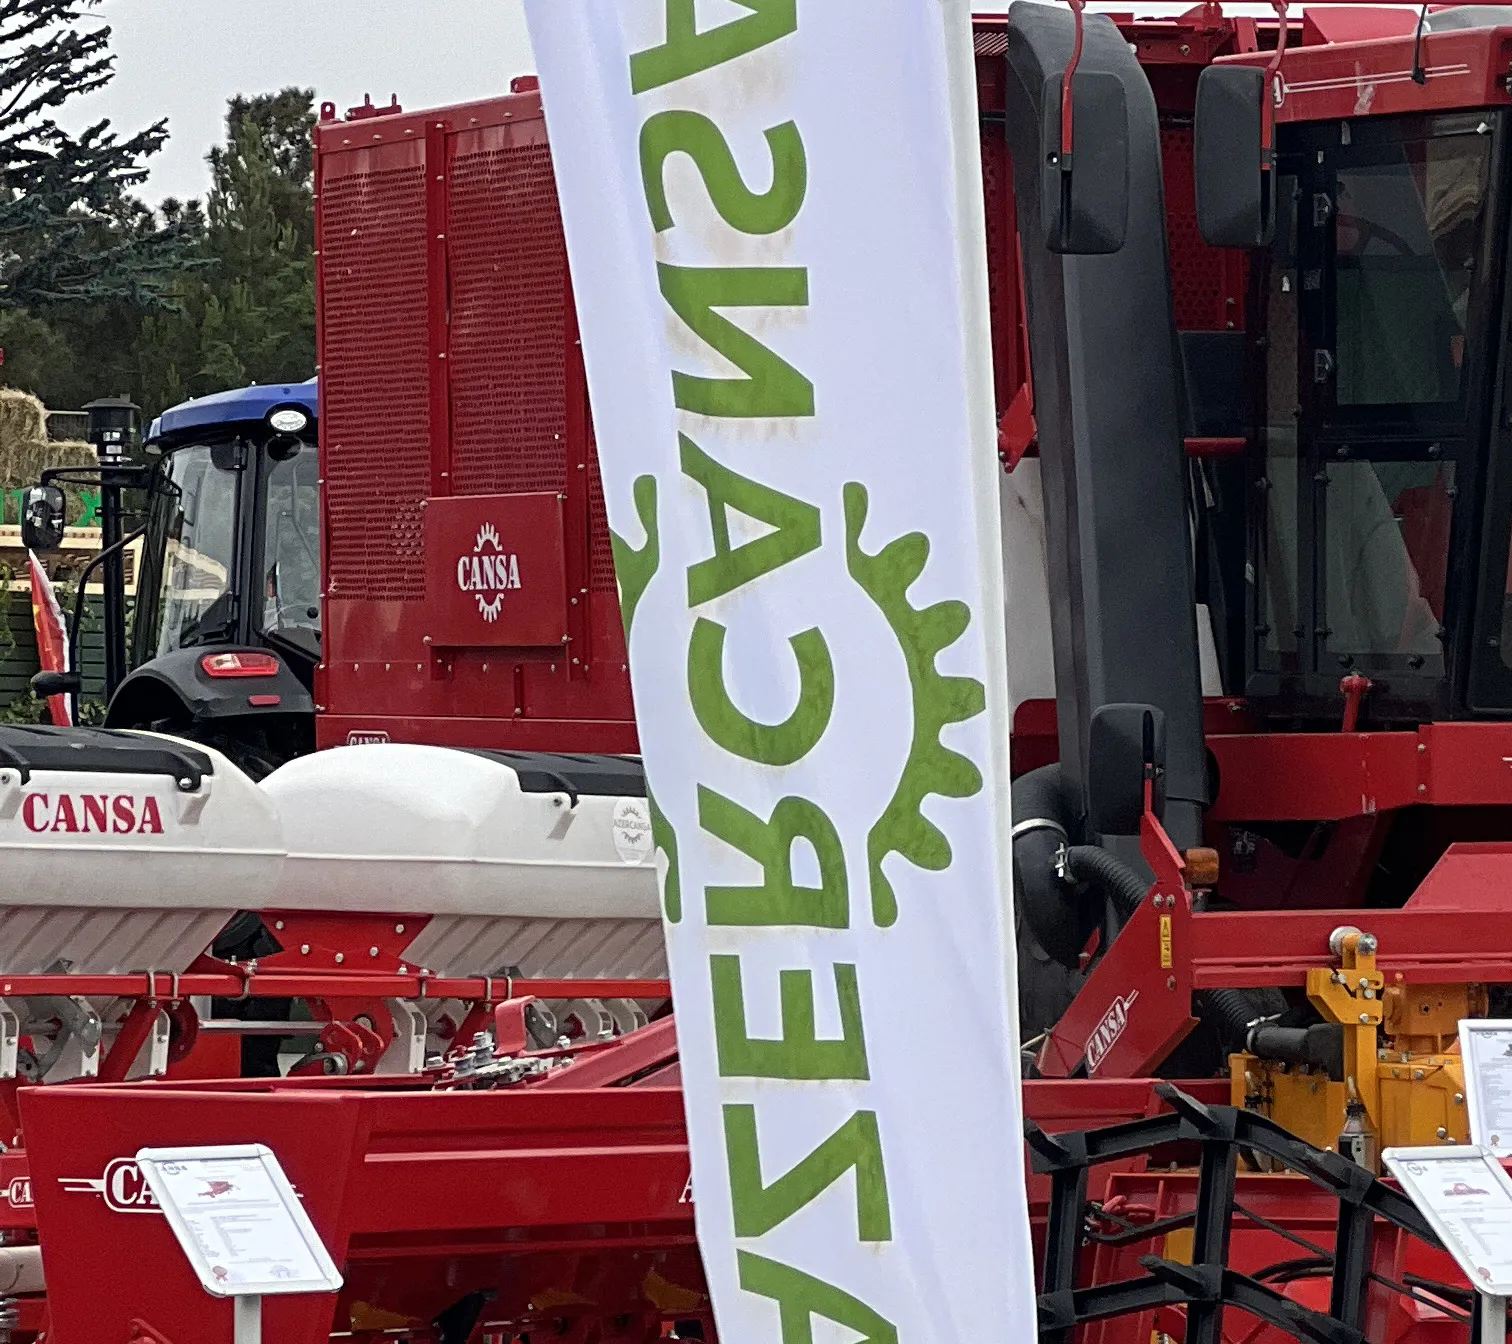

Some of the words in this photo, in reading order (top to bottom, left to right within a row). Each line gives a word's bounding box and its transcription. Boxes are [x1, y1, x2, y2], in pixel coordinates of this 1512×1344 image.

[457, 554, 522, 591] CANSA
[23, 792, 165, 834] CANSA
[1087, 1002, 1125, 1067] CANSA
